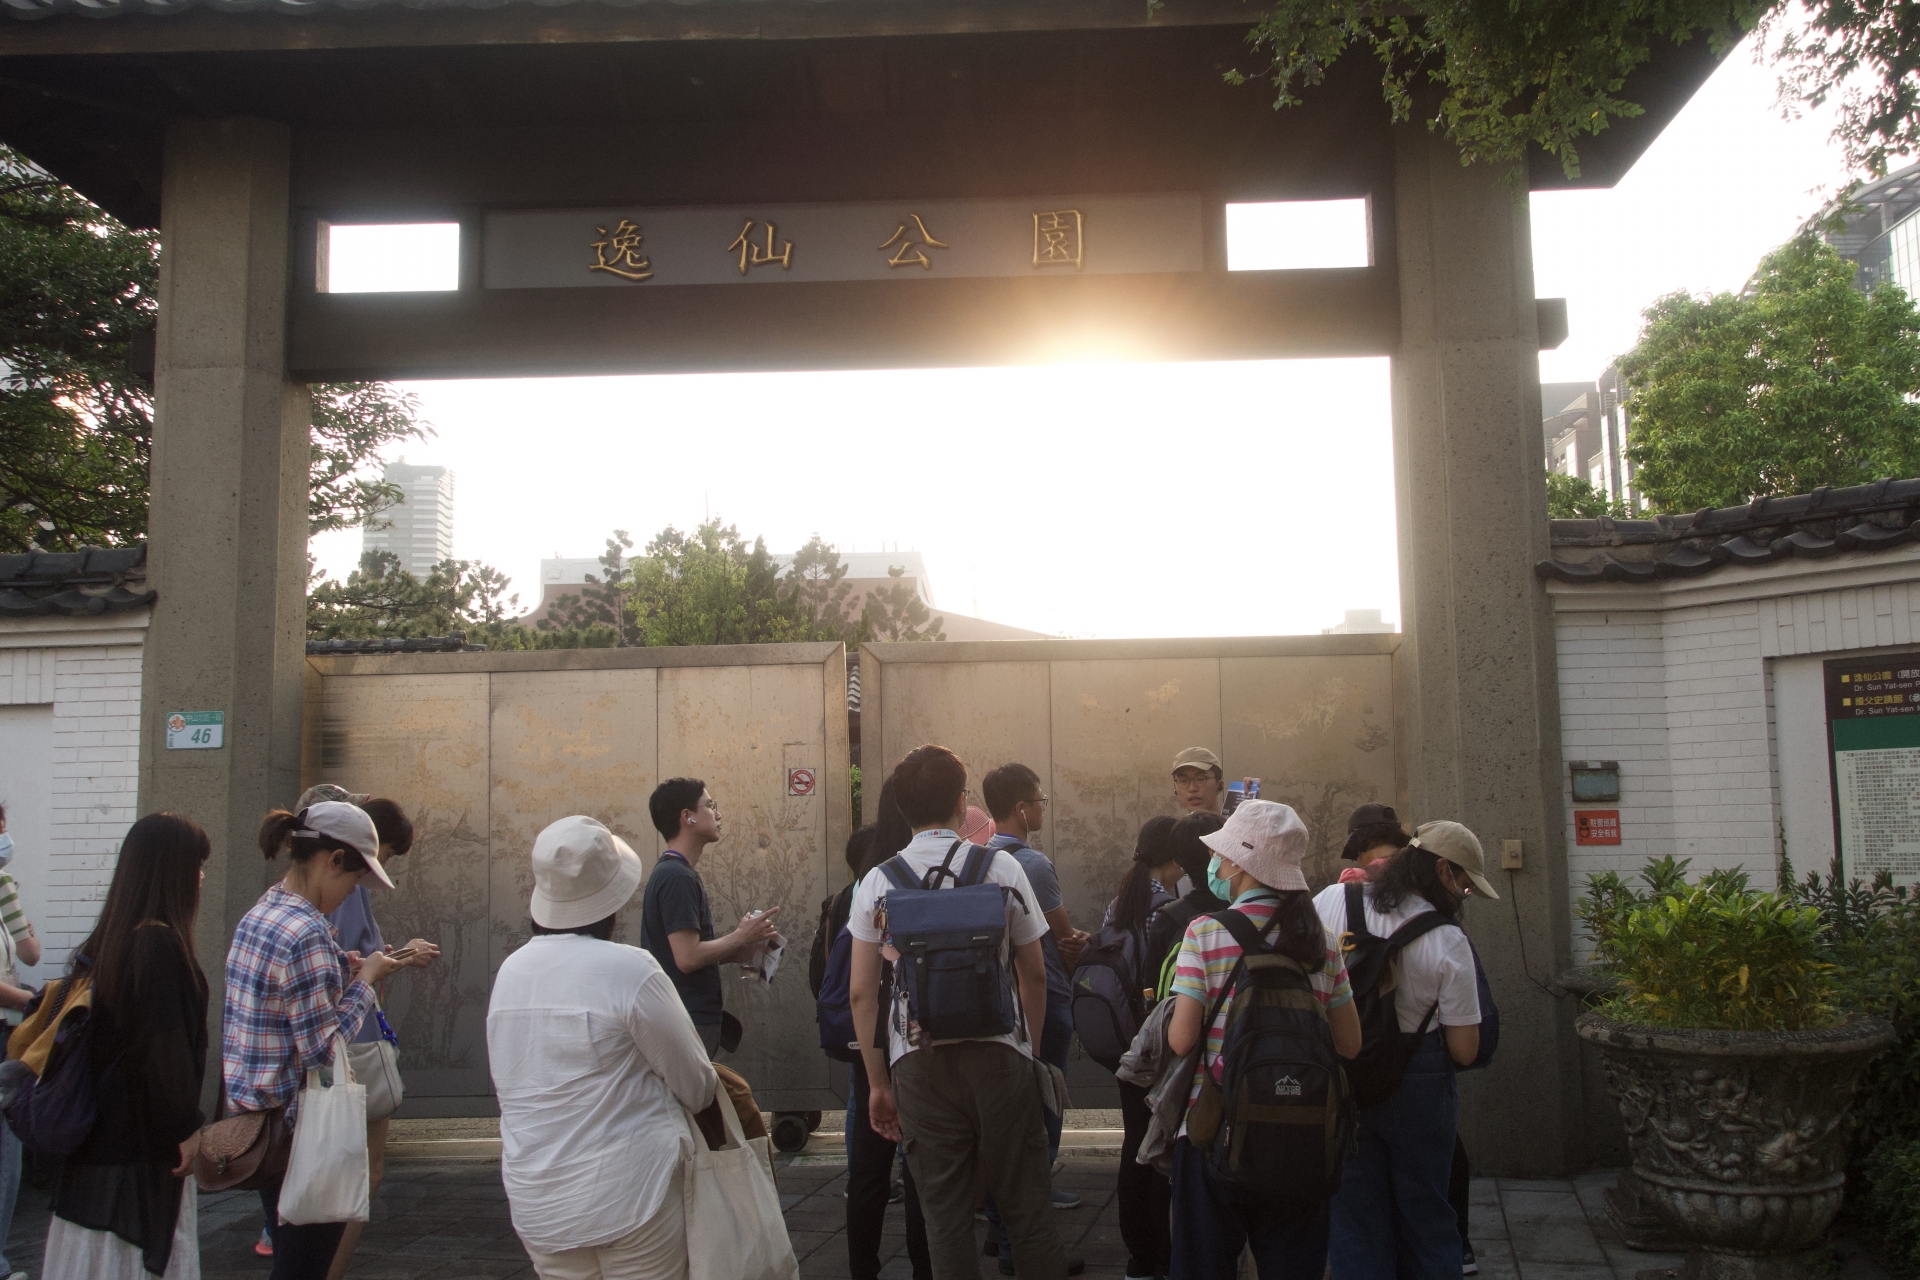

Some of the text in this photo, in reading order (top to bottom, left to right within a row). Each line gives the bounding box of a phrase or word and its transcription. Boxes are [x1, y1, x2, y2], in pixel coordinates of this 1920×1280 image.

[588, 209, 1084, 281] 逸仙公園
[1854, 671, 1891, 682] 逸仙公園
[1884, 682, 1912, 690] Yat-sen
[190, 728, 212, 743] 46
[1591, 829, 1618, 838] 安全有我
